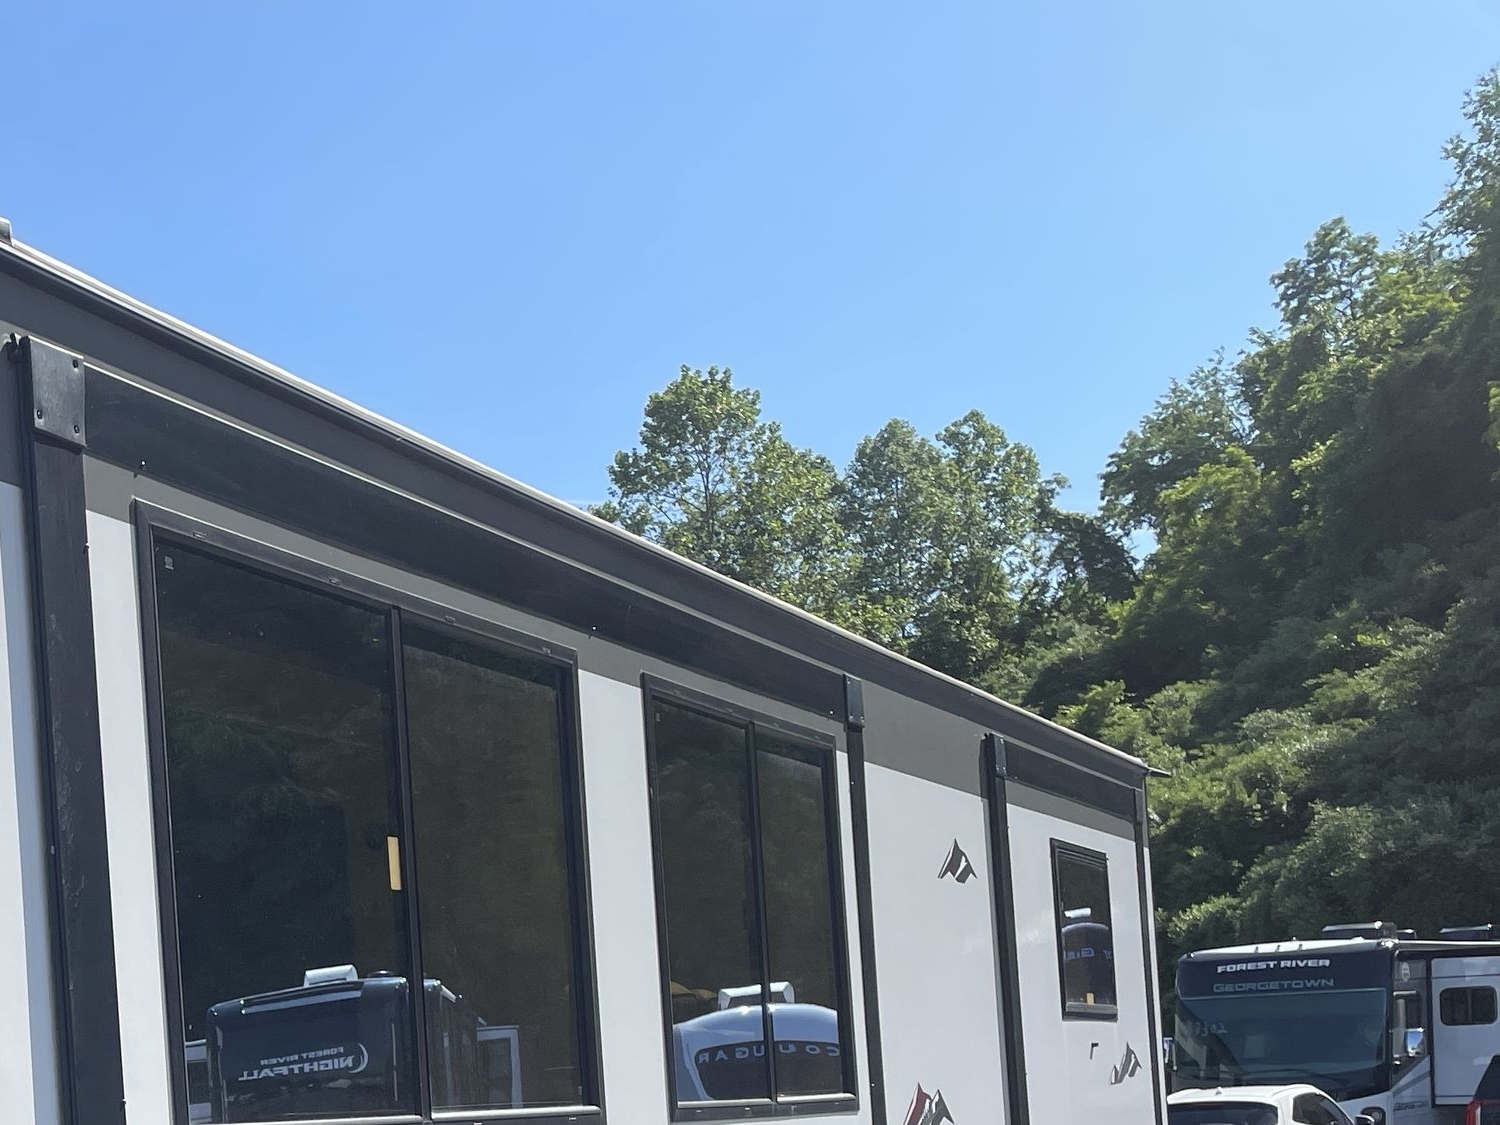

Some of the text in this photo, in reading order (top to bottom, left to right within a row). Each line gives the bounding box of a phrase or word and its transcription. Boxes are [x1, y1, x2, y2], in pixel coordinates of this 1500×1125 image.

[1217, 959, 1330, 974] FOREST RIVER
[1213, 978, 1334, 993] GEORGETOWN
